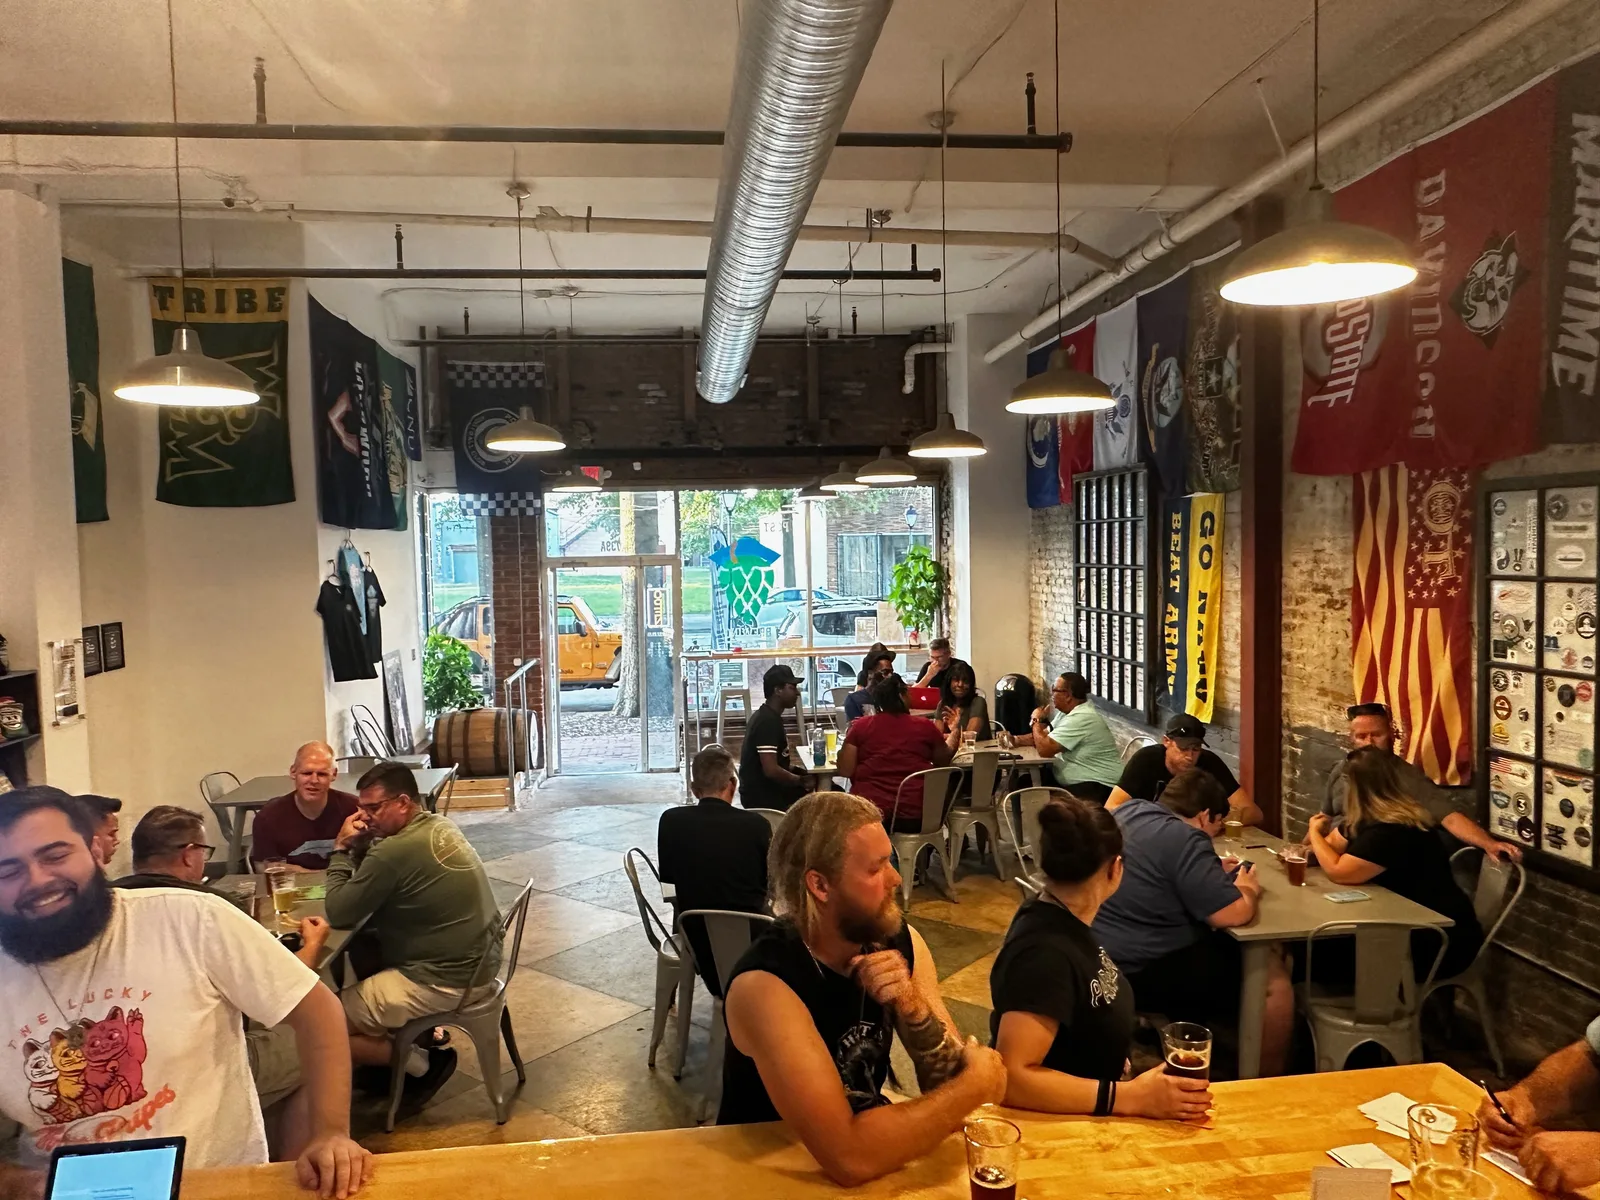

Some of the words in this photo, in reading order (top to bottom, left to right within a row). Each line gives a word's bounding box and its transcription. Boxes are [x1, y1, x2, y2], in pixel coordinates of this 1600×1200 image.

[1551, 112, 1600, 396] MARITIME
[152, 284, 287, 314] TRIBE
[1169, 512, 1182, 594] BEAT
[1198, 510, 1215, 571] GO
[67, 986, 152, 1010] LUCKY
